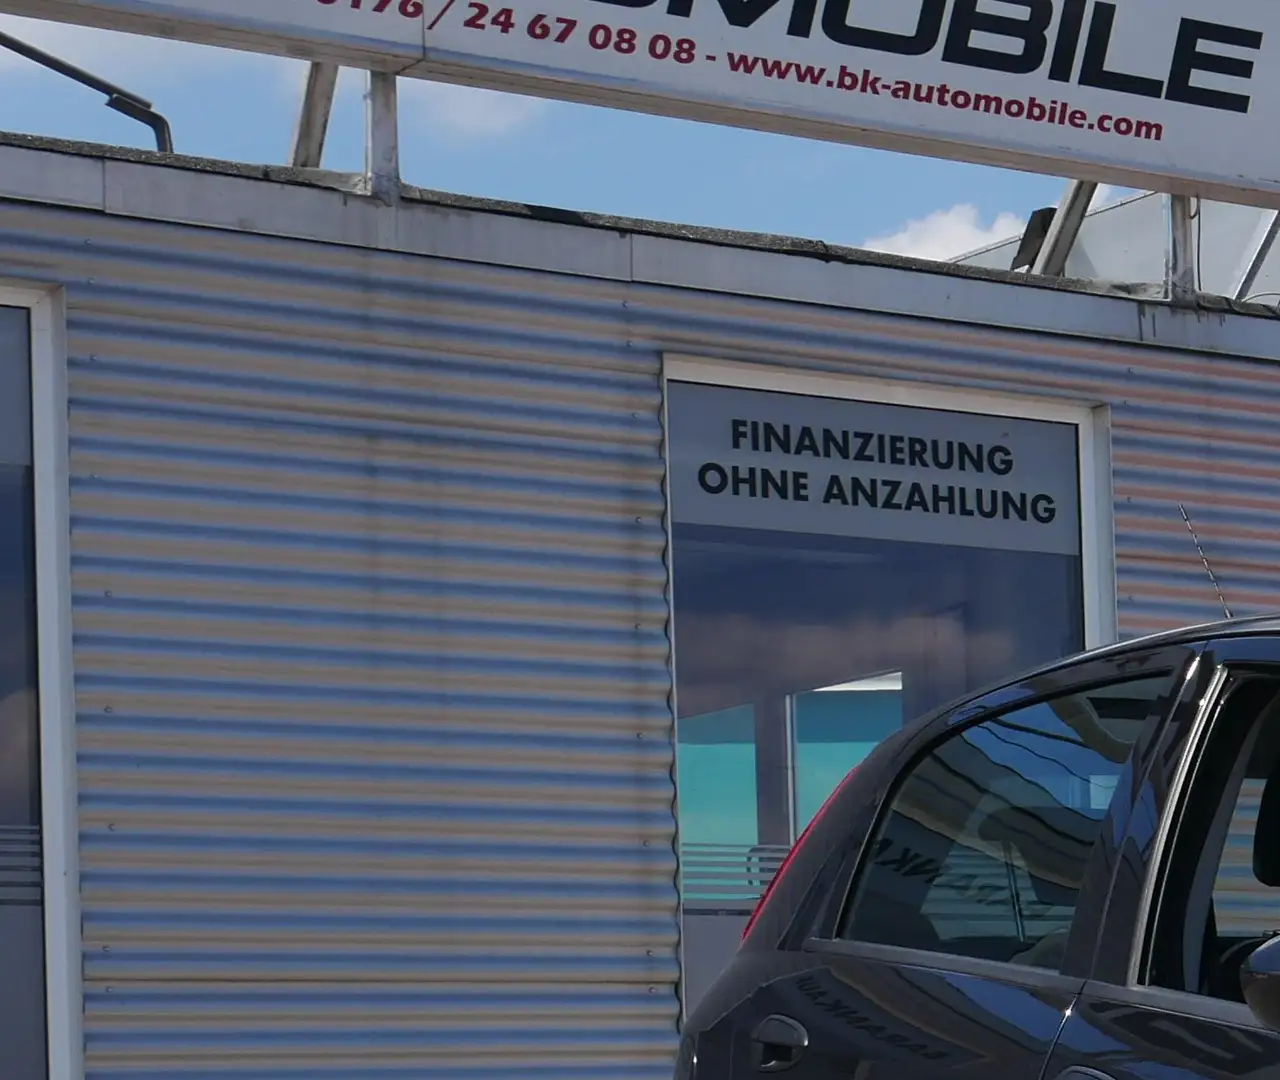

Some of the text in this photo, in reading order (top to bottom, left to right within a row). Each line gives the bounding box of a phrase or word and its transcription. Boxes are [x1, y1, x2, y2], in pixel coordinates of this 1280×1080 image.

[463, 2, 515, 34] 24
[527, 13, 577, 43] 67
[588, 24, 637, 54] 08
[648, 34, 696, 64] 08
[727, 52, 1163, 141] www.bk-automobile.com
[590, 0, 1263, 113] OBILE
[731, 418, 1014, 476] FINANZIERUNG
[698, 462, 1056, 524] OHNE ANZAHLUNG
